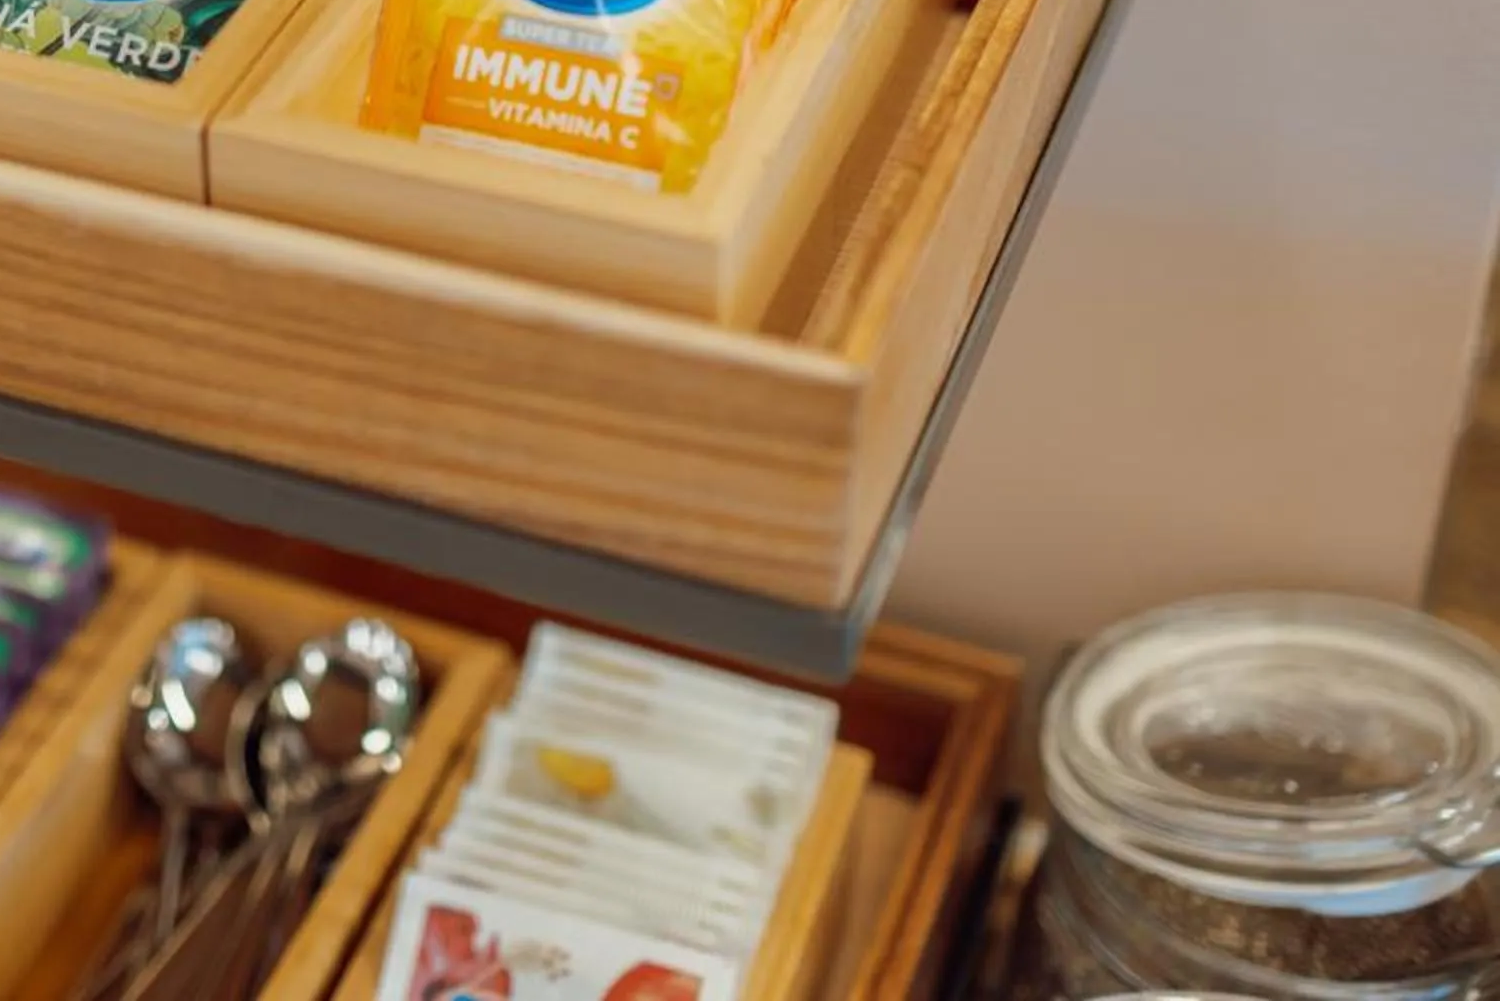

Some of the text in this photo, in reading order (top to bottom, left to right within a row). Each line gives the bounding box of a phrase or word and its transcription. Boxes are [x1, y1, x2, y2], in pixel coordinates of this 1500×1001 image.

[453, 43, 651, 119] IMMUNE
[488, 96, 641, 150] VITAMINA C
